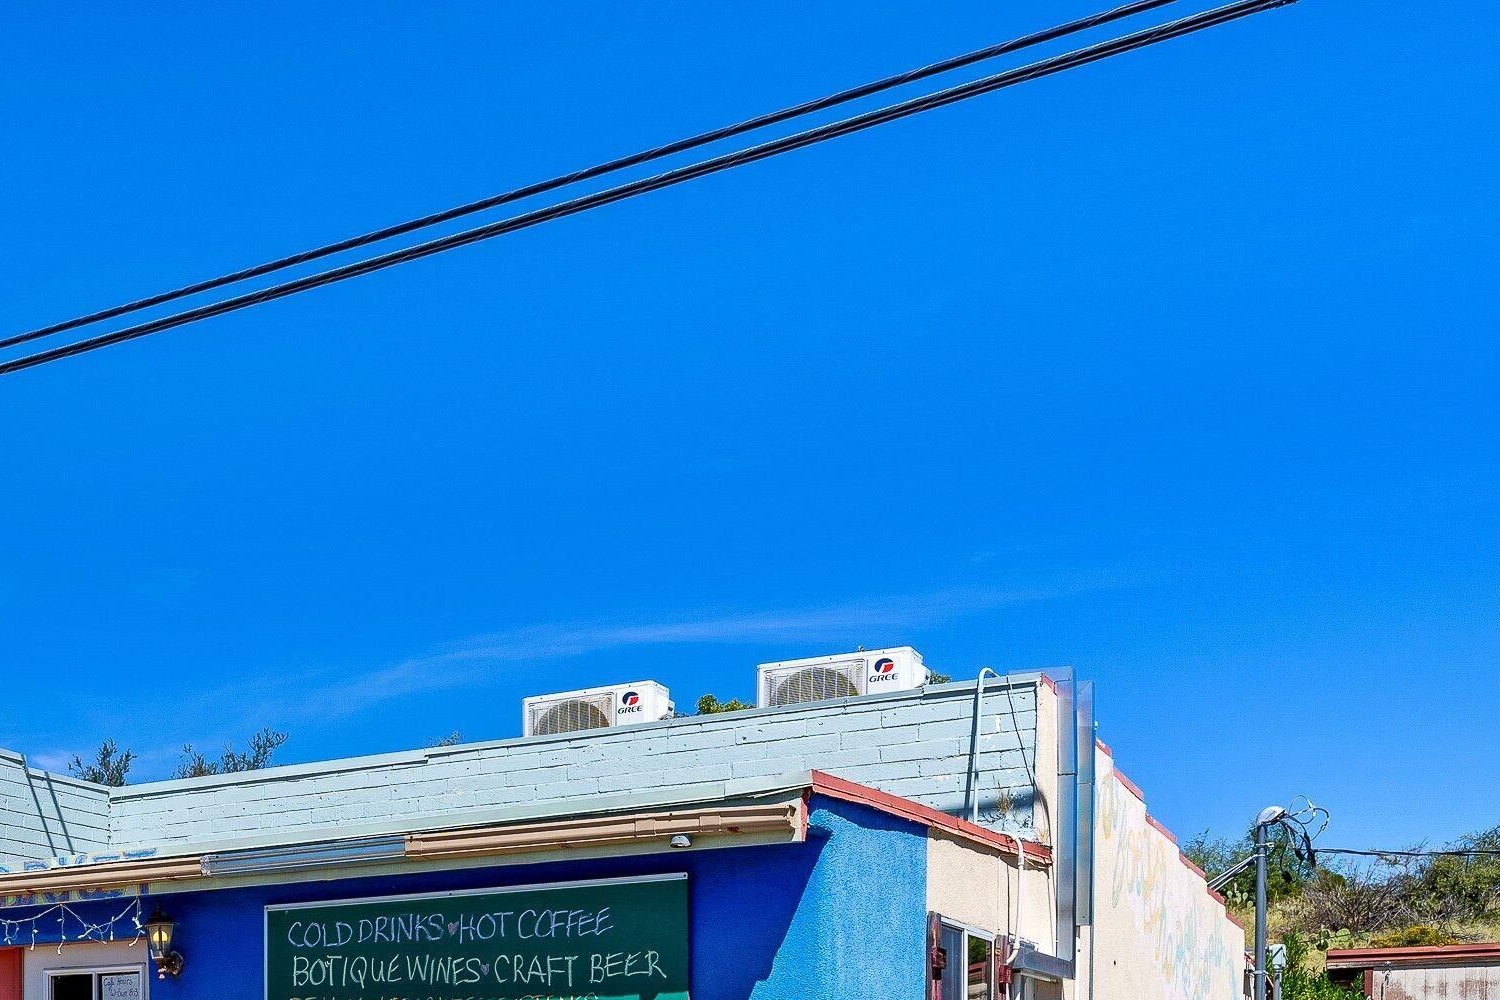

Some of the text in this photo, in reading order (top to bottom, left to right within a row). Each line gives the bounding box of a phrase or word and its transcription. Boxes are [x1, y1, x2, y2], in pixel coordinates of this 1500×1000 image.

[869, 673, 899, 683] GREE
[618, 705, 643, 715] GREE
[288, 907, 614, 947] COLD DRINKS HOT COFFEE
[406, 954, 481, 986] WINES
[495, 954, 579, 987] CRAFT
[589, 950, 667, 983] BEER
